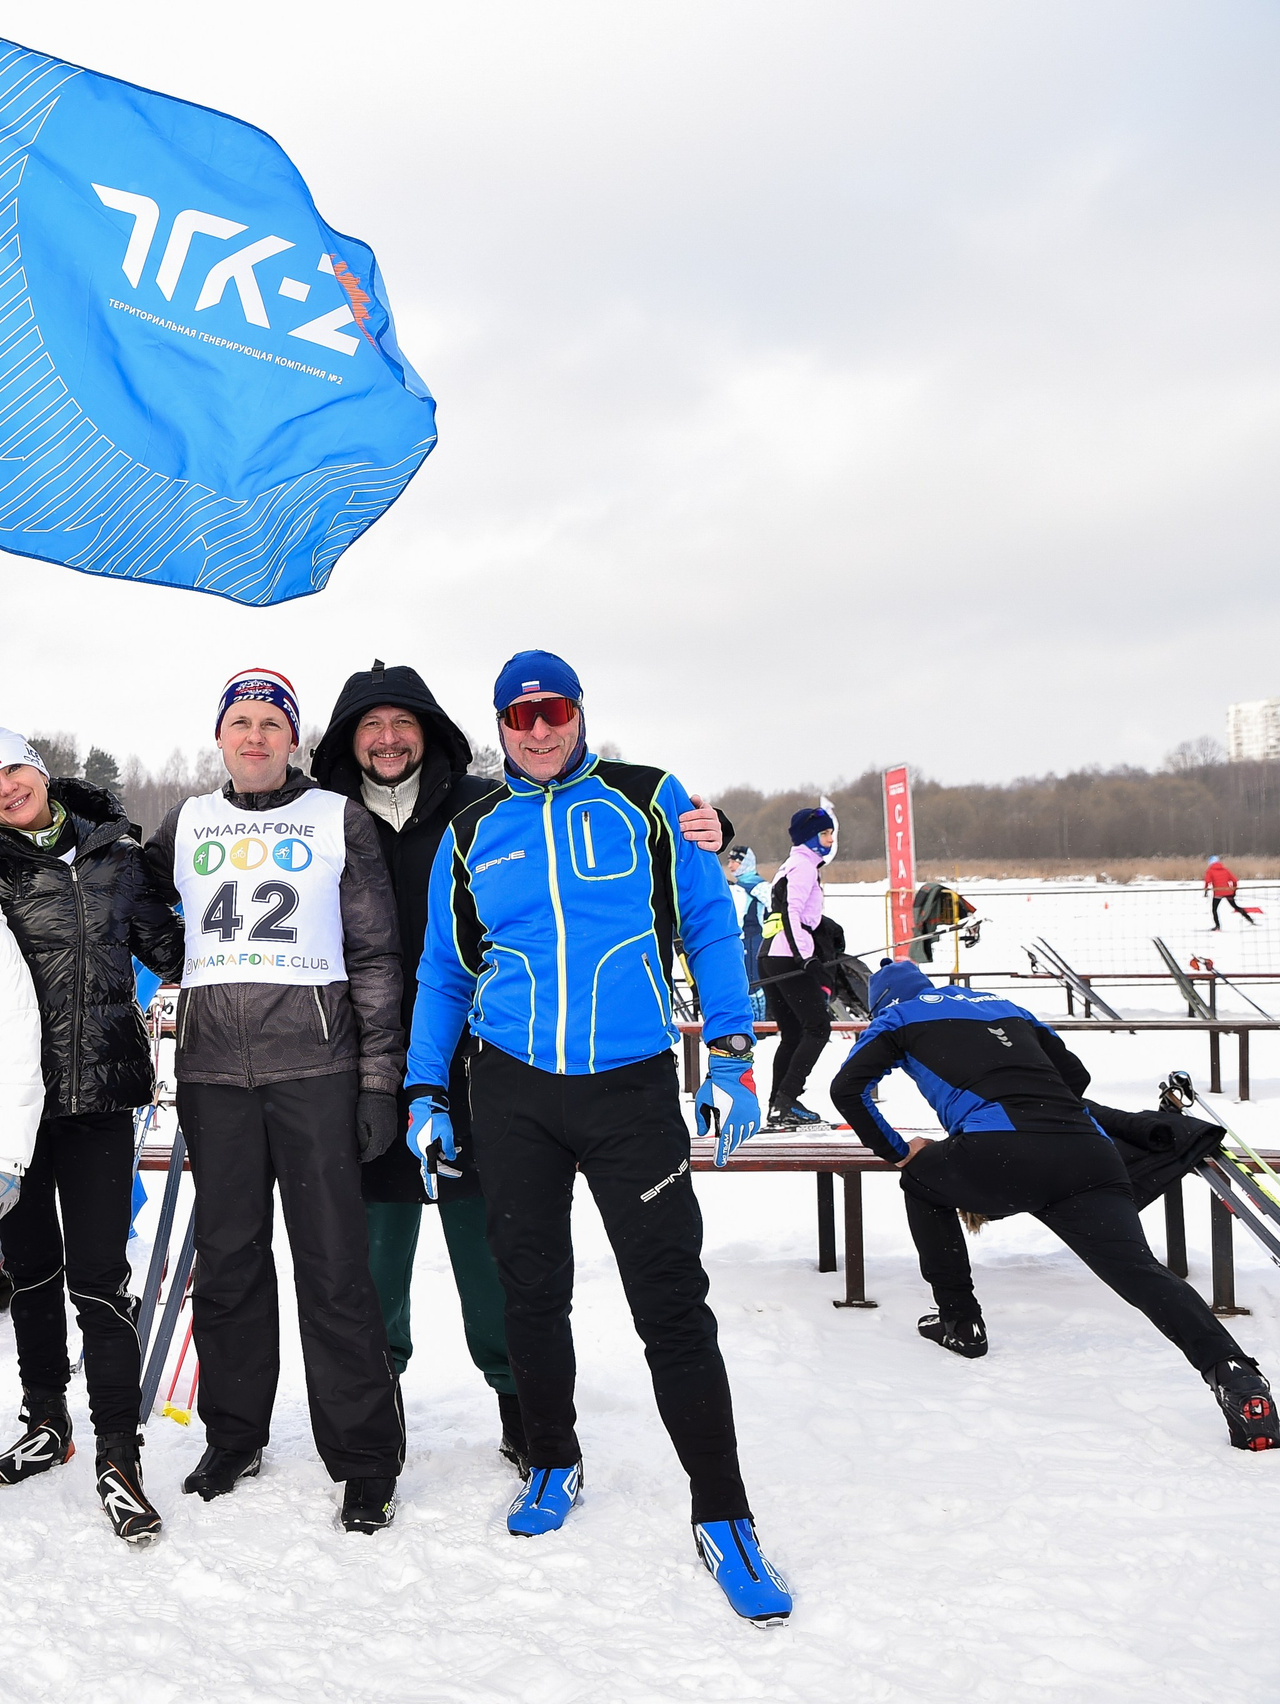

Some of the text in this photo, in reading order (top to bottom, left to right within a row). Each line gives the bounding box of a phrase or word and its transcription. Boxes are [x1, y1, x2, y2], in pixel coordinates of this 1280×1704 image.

[108, 298, 343, 385] ТЕРРИТОРИАЛЬНАЯ ГЕНЕРИРУЮЩАЯ КОМПАНИЯ №2
[193, 822, 316, 841] VMARAFONE
[475, 849, 526, 874] SPINE
[894, 803, 908, 934] СТАРТ
[200, 879, 300, 944] 42
[193, 953, 330, 971] VMARAFONE.CLUB
[639, 1158, 689, 1203] SPINE
